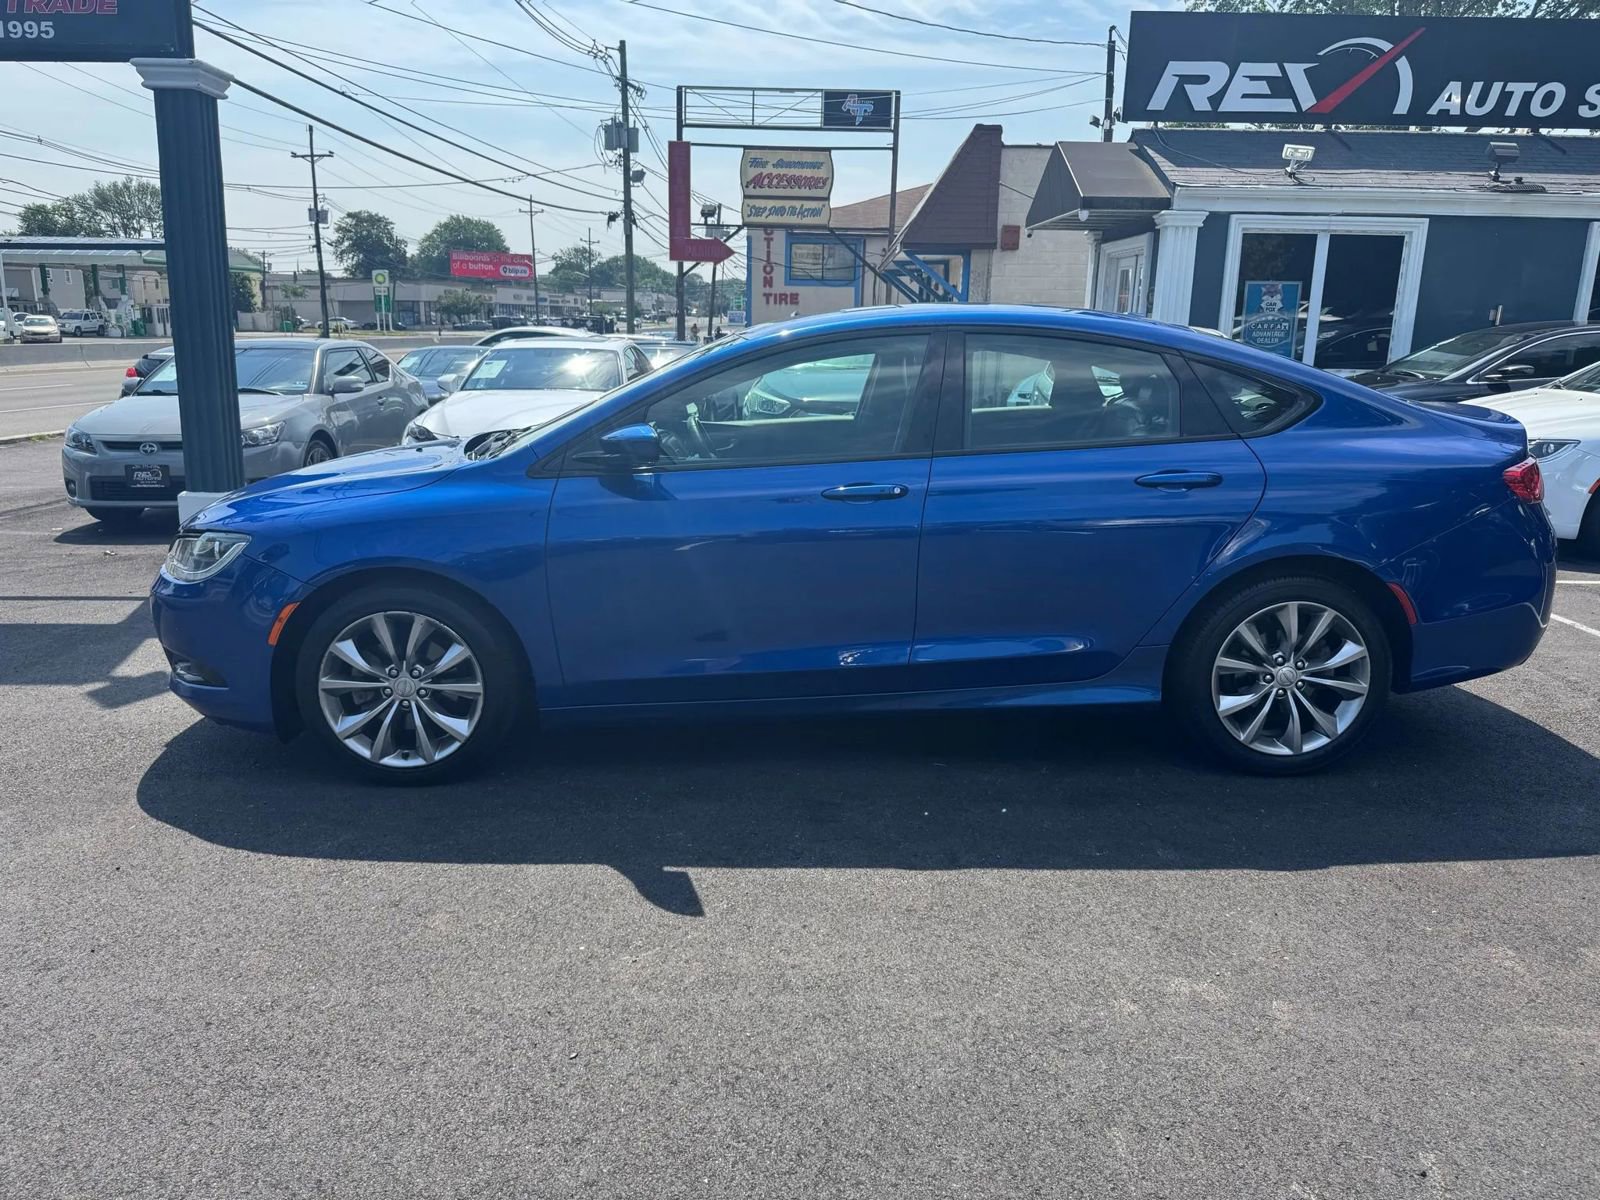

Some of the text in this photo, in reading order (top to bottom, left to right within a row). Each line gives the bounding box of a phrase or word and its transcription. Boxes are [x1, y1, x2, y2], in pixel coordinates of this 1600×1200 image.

[1146, 42, 1410, 113] REV
[1426, 81, 1566, 118] AUTO
[763, 293, 799, 305] TIRE
